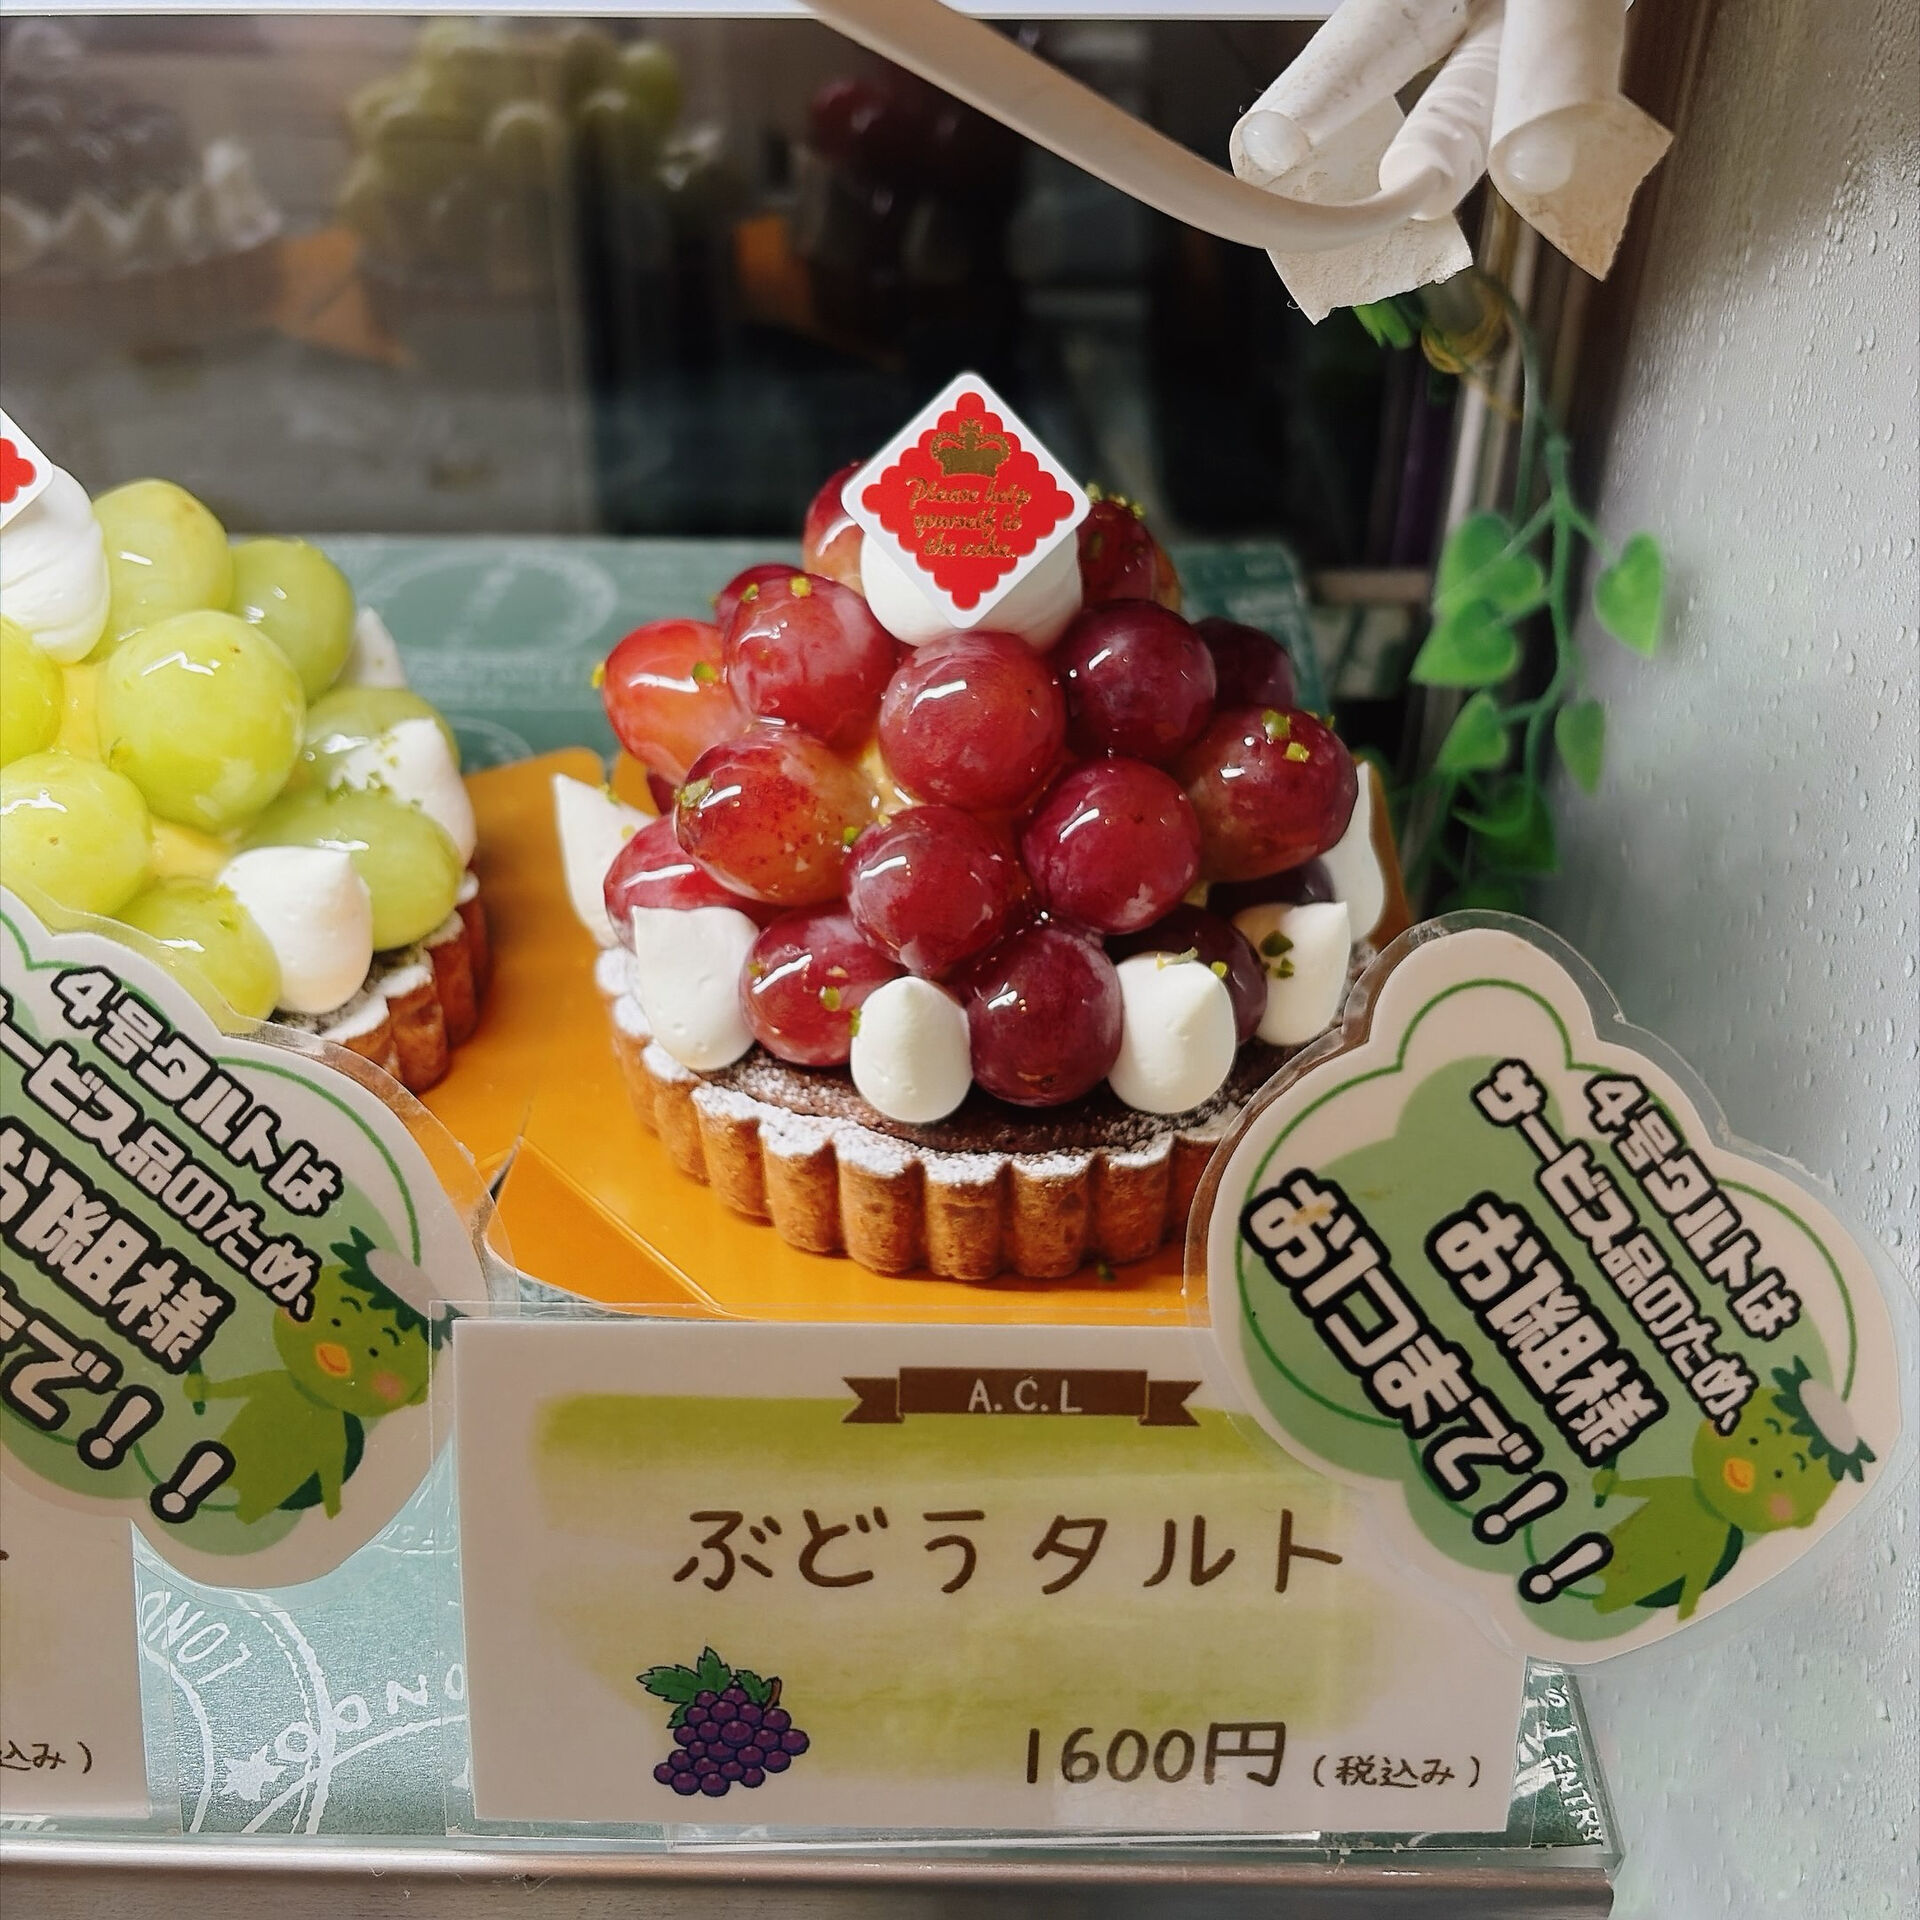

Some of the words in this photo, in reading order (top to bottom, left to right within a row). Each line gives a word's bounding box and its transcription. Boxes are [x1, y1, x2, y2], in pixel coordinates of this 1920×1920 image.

[905, 477, 980, 510] Please
[984, 478, 1032, 514] help
[914, 506, 998, 539] yourself
[924, 532, 957, 557] the
[51, 965, 344, 1217] 4号タルトは
[0, 988, 316, 1322] ービス品のため、
[1585, 1072, 1802, 1340] 4号タルトは
[1470, 1057, 1758, 1437] サービス品のため、
[1423, 1190, 1670, 1468] お1組様
[967, 1377, 1083, 1414] A.C.L
[674, 1506, 1344, 1594] ぶどうタルト
[1026, 1721, 1286, 1787] 1600円
[1313, 1754, 1480, 1789] （税込み）
